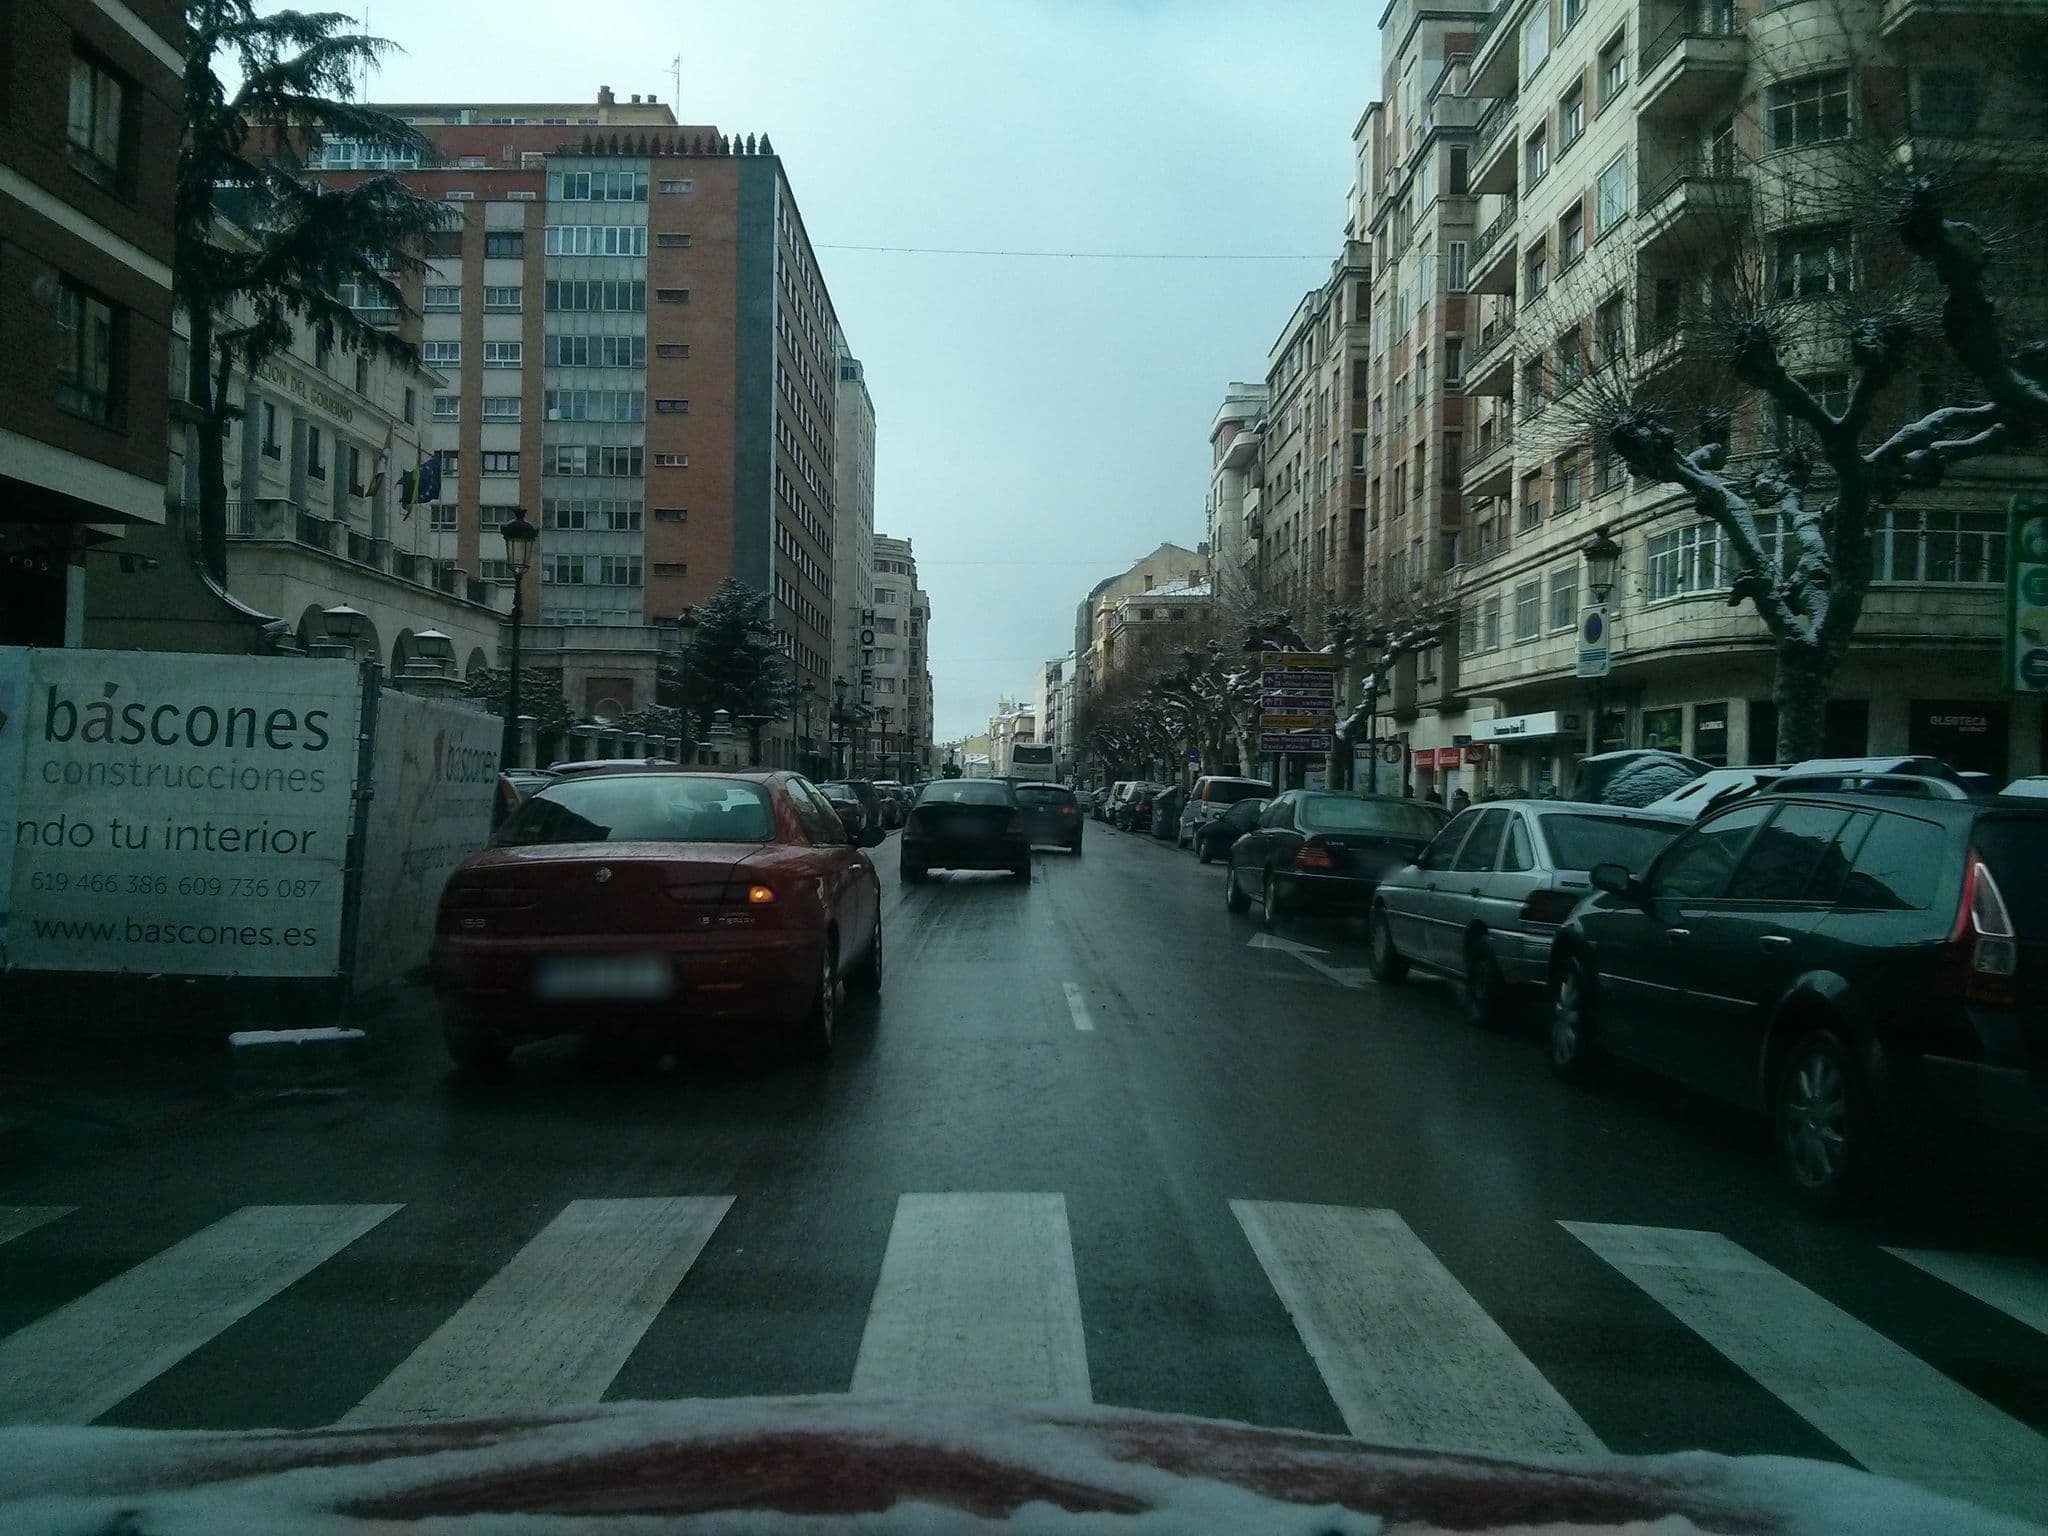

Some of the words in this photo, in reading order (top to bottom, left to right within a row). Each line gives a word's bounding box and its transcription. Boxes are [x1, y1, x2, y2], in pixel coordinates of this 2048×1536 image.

[861, 609, 875, 704] HOTEL
[45, 681, 329, 751] báscones
[43, 757, 325, 793] construcciones
[16, 814, 94, 847] ndo
[109, 818, 148, 849] tu
[165, 817, 317, 854] interior
[31, 872, 69, 891] 619
[75, 874, 118, 893] 466
[126, 875, 168, 895] 386
[178, 877, 221, 896] 609
[231, 879, 269, 897] 736
[277, 880, 320, 898] 087
[33, 916, 317, 947] www.bascones.es
